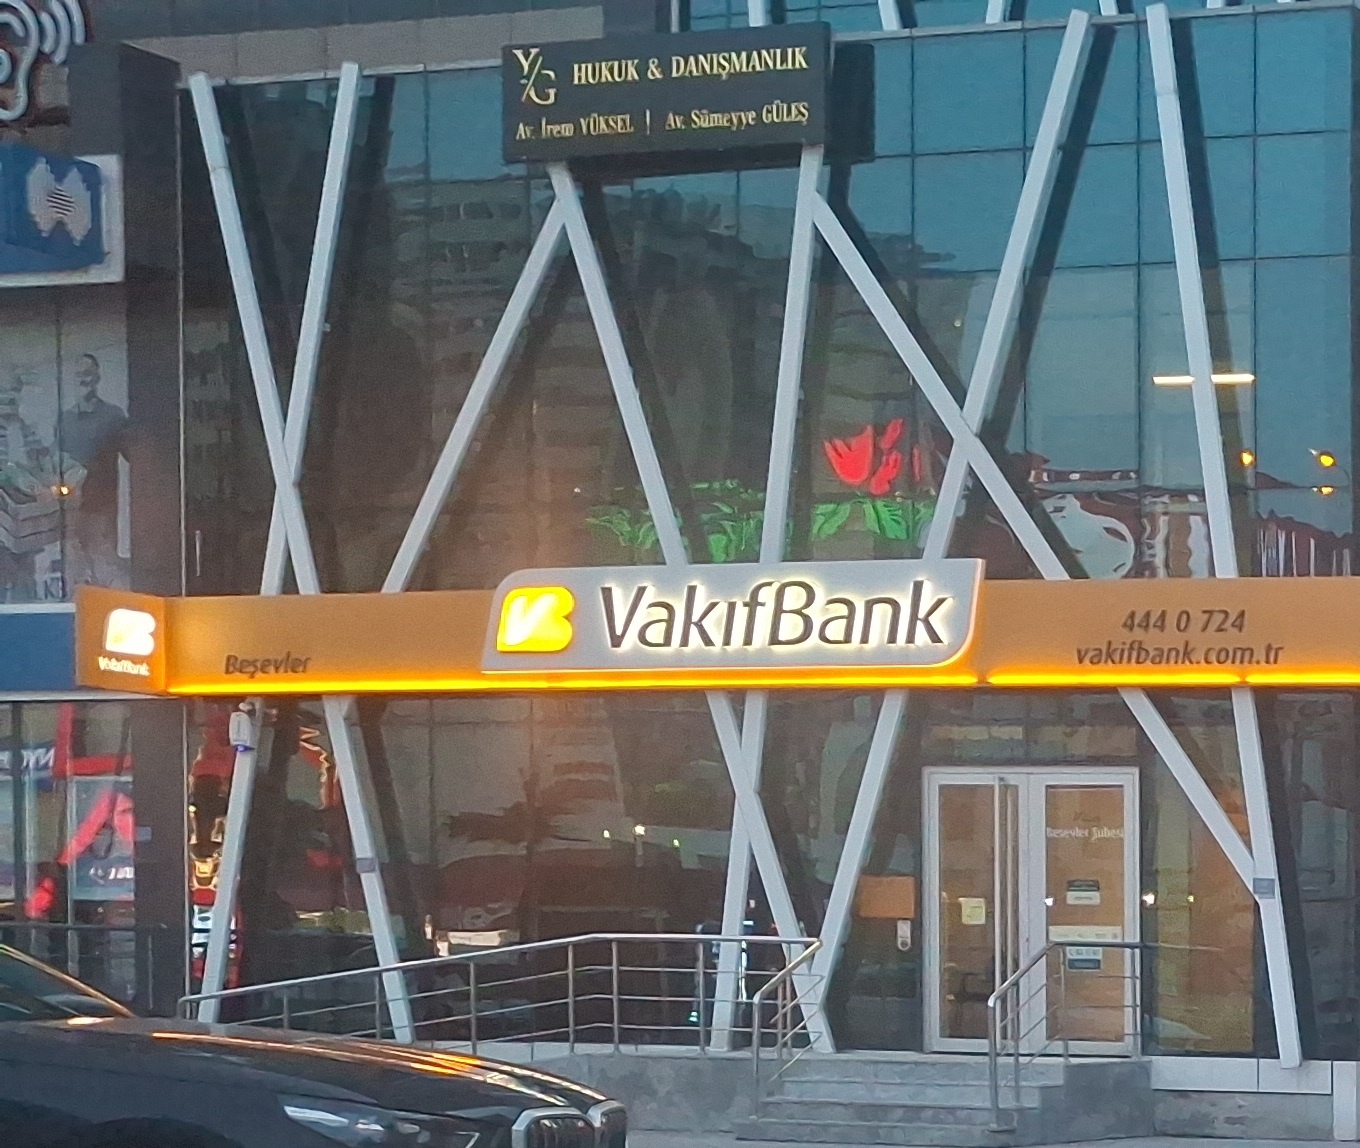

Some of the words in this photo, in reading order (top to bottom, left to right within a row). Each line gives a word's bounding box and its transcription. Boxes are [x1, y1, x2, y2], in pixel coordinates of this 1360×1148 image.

[572, 59, 639, 85] HUKUK
[647, 58, 662, 79] &
[671, 47, 809, 80] DANIŞMANLIK
[691, 109, 757, 130] Sümeyye
[762, 100, 809, 126] GÜLEŞ
[600, 579, 953, 649] VakıfBank
[1121, 609, 1166, 633] 444
[1176, 609, 1190, 633] 0
[1200, 609, 1246, 633] 724
[225, 651, 311, 678] Beşevler
[1076, 641, 1285, 665] vakifbank.com.tr
